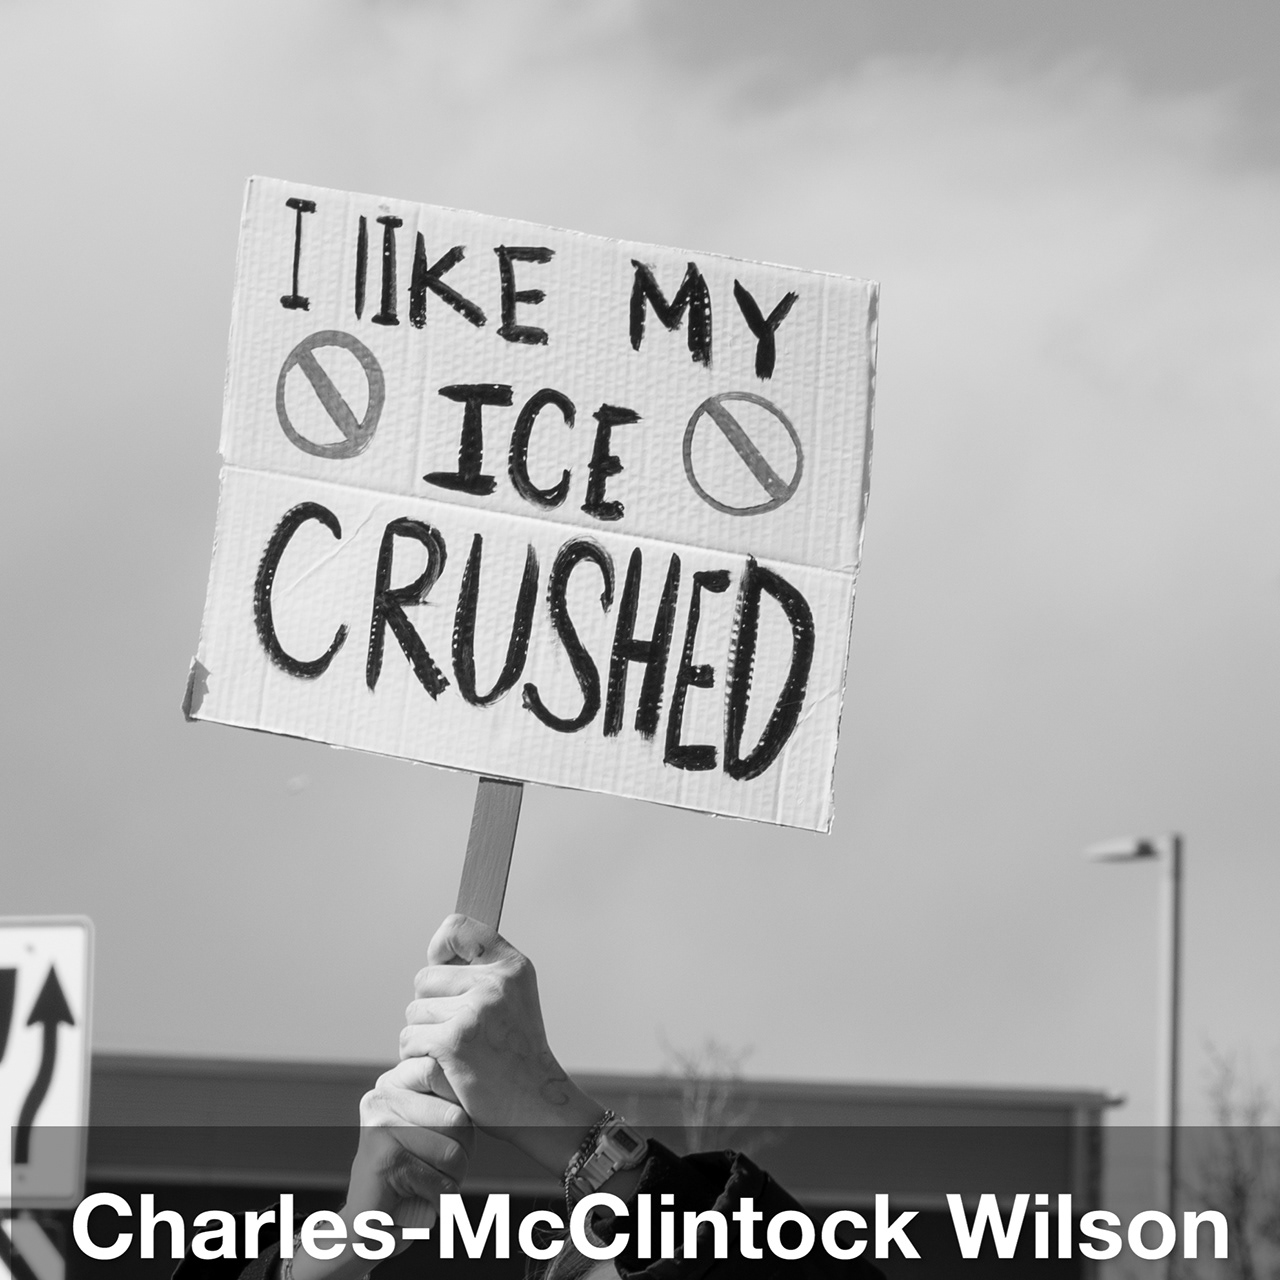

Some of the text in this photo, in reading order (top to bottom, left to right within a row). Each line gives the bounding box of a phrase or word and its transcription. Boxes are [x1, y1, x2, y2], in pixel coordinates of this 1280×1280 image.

[280, 197, 317, 312] I
[629, 258, 800, 382] MY
[422, 382, 643, 522] ICE
[253, 500, 817, 782] CRUSHED
